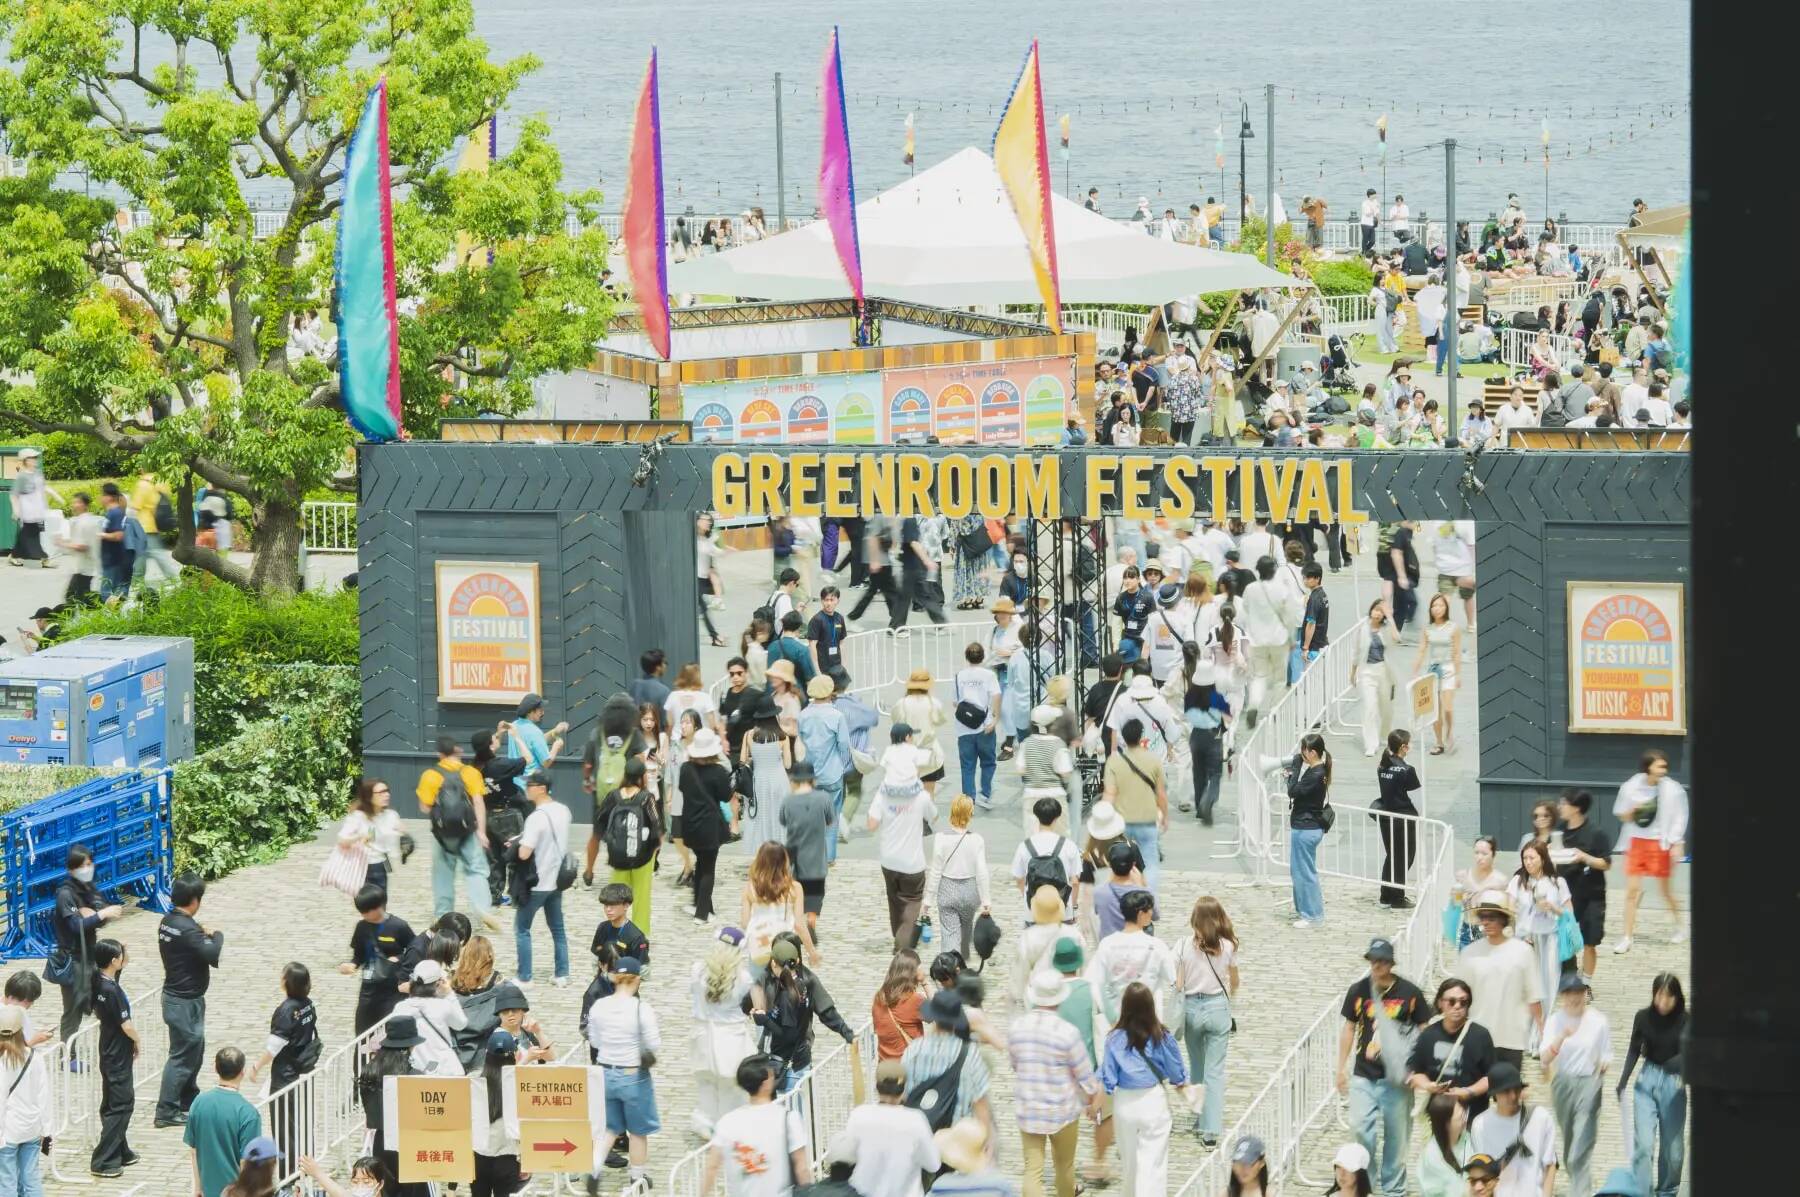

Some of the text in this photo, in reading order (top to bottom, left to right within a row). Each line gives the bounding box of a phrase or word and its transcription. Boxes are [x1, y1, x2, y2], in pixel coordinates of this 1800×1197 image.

[711, 451, 1369, 525] GREENROOM FESTIVAL
[452, 619, 528, 639] FESTIVAL
[1584, 643, 1670, 665] FESTIVAL
[452, 662, 490, 687] MUSIC
[503, 664, 528, 689] ART
[1585, 690, 1628, 716] MUSIC
[1642, 691, 1670, 717] ART
[520, 1082, 584, 1093] RE-ENTRANCE
[421, 1091, 447, 1104] 1DAY
[531, 1095, 573, 1107] 再入場口
[424, 1106, 445, 1116] 1日券
[416, 1150, 455, 1163] 最後尾
